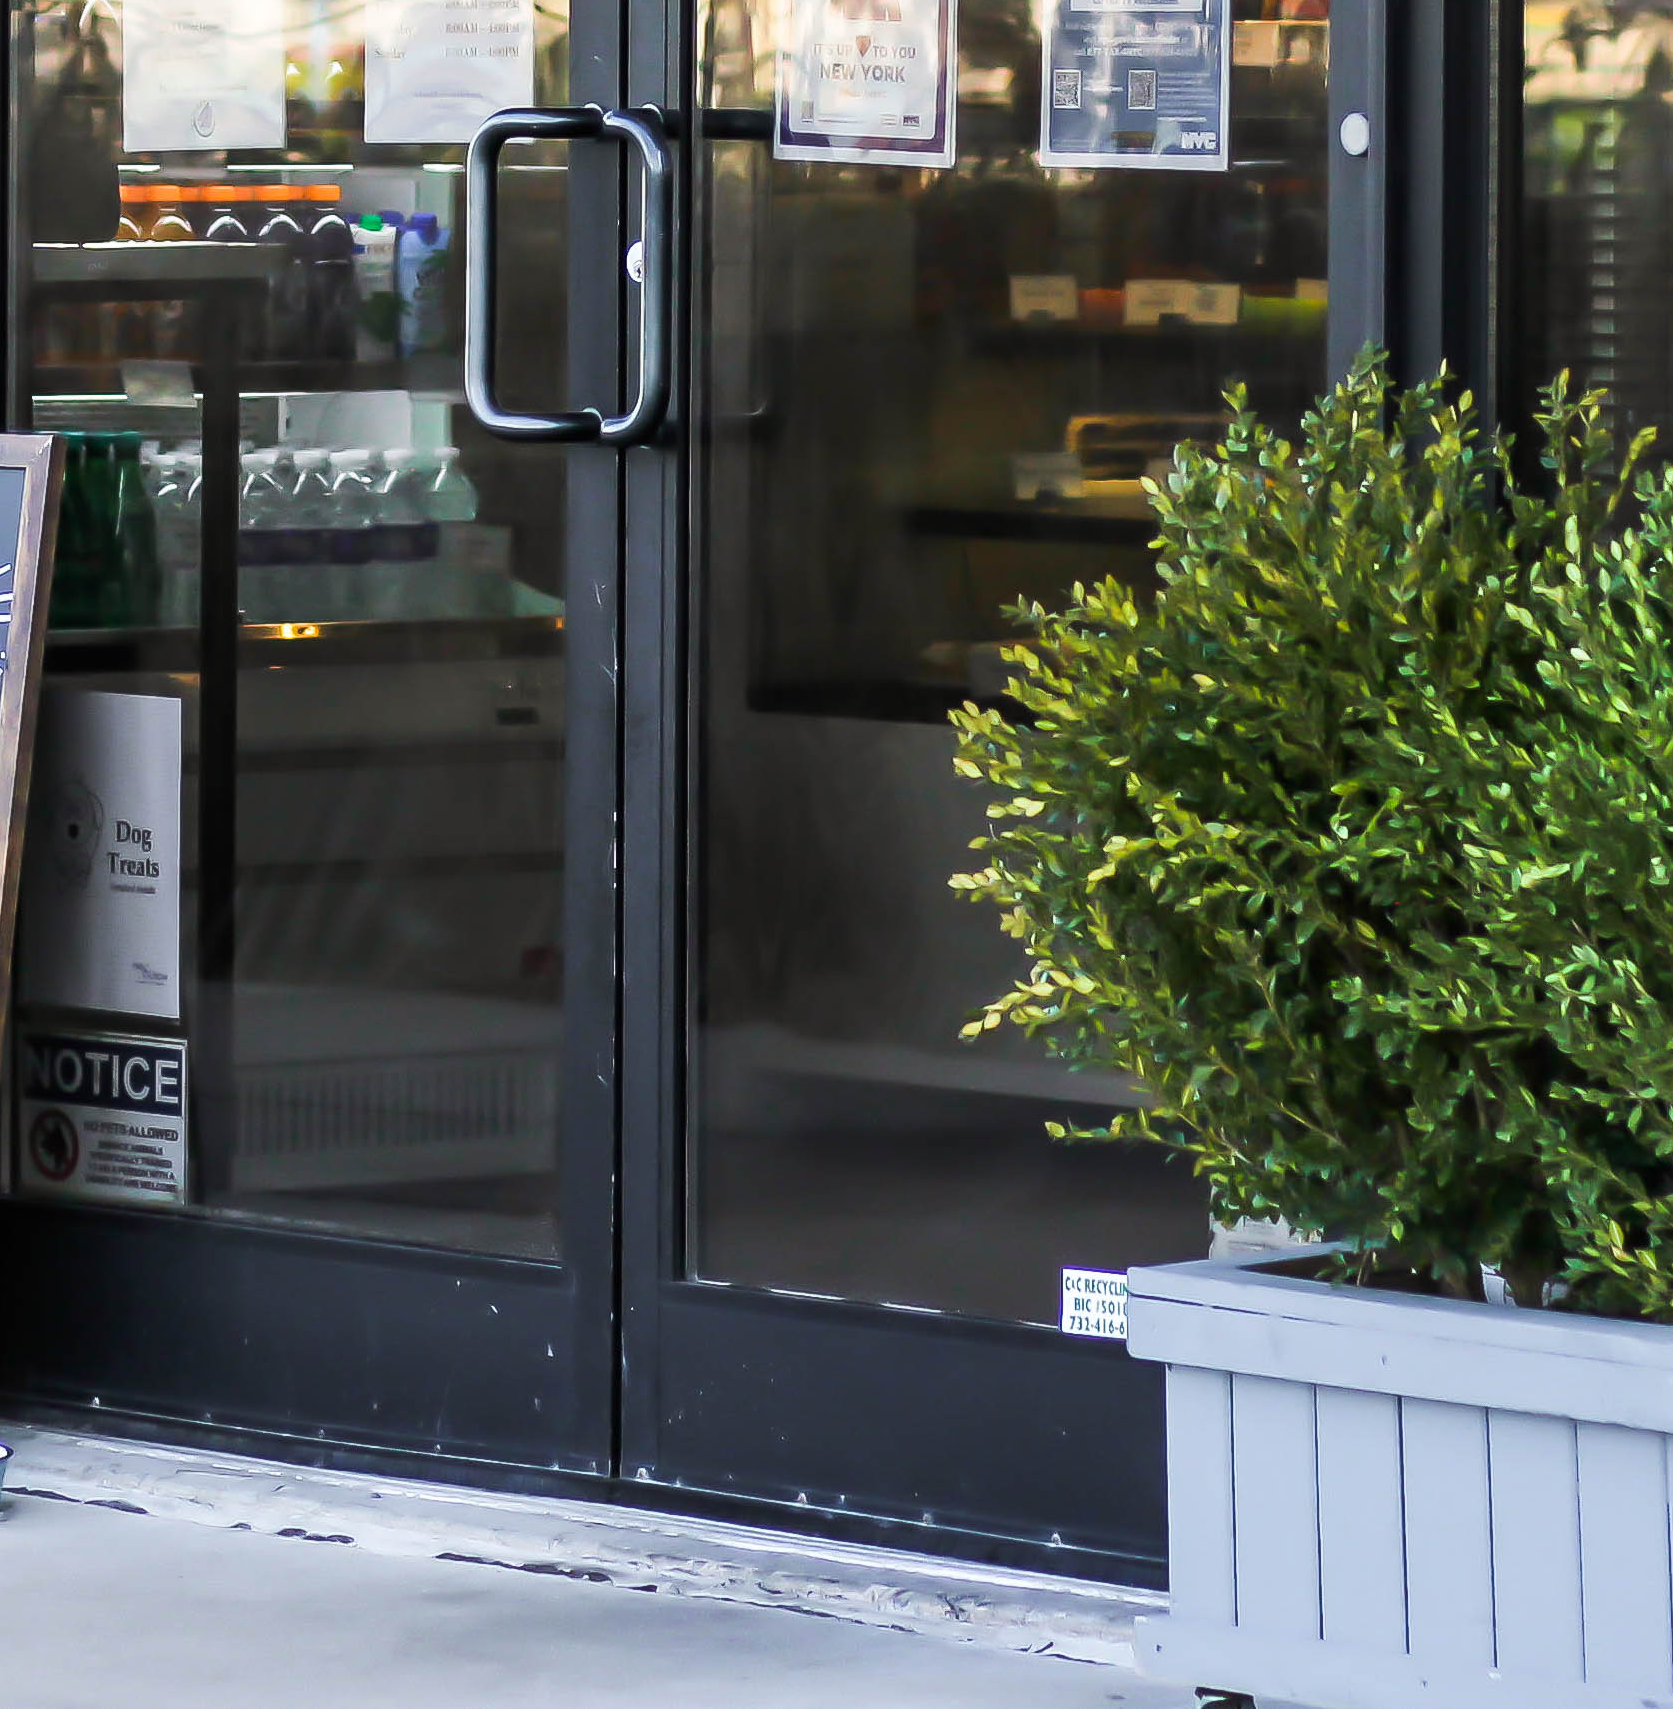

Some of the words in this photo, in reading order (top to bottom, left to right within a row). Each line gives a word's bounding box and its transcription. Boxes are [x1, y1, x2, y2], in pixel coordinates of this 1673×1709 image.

[820, 63, 856, 81] NEW
[861, 64, 905, 83] YORK
[115, 820, 152, 853] Dog
[107, 852, 160, 878] Treats
[29, 1046, 179, 1104] NOTICE
[1084, 1278, 1128, 1296] RECYCLIN
[1074, 1297, 1091, 1313] BIC
[1069, 1315, 1125, 1335] 732-416-6
